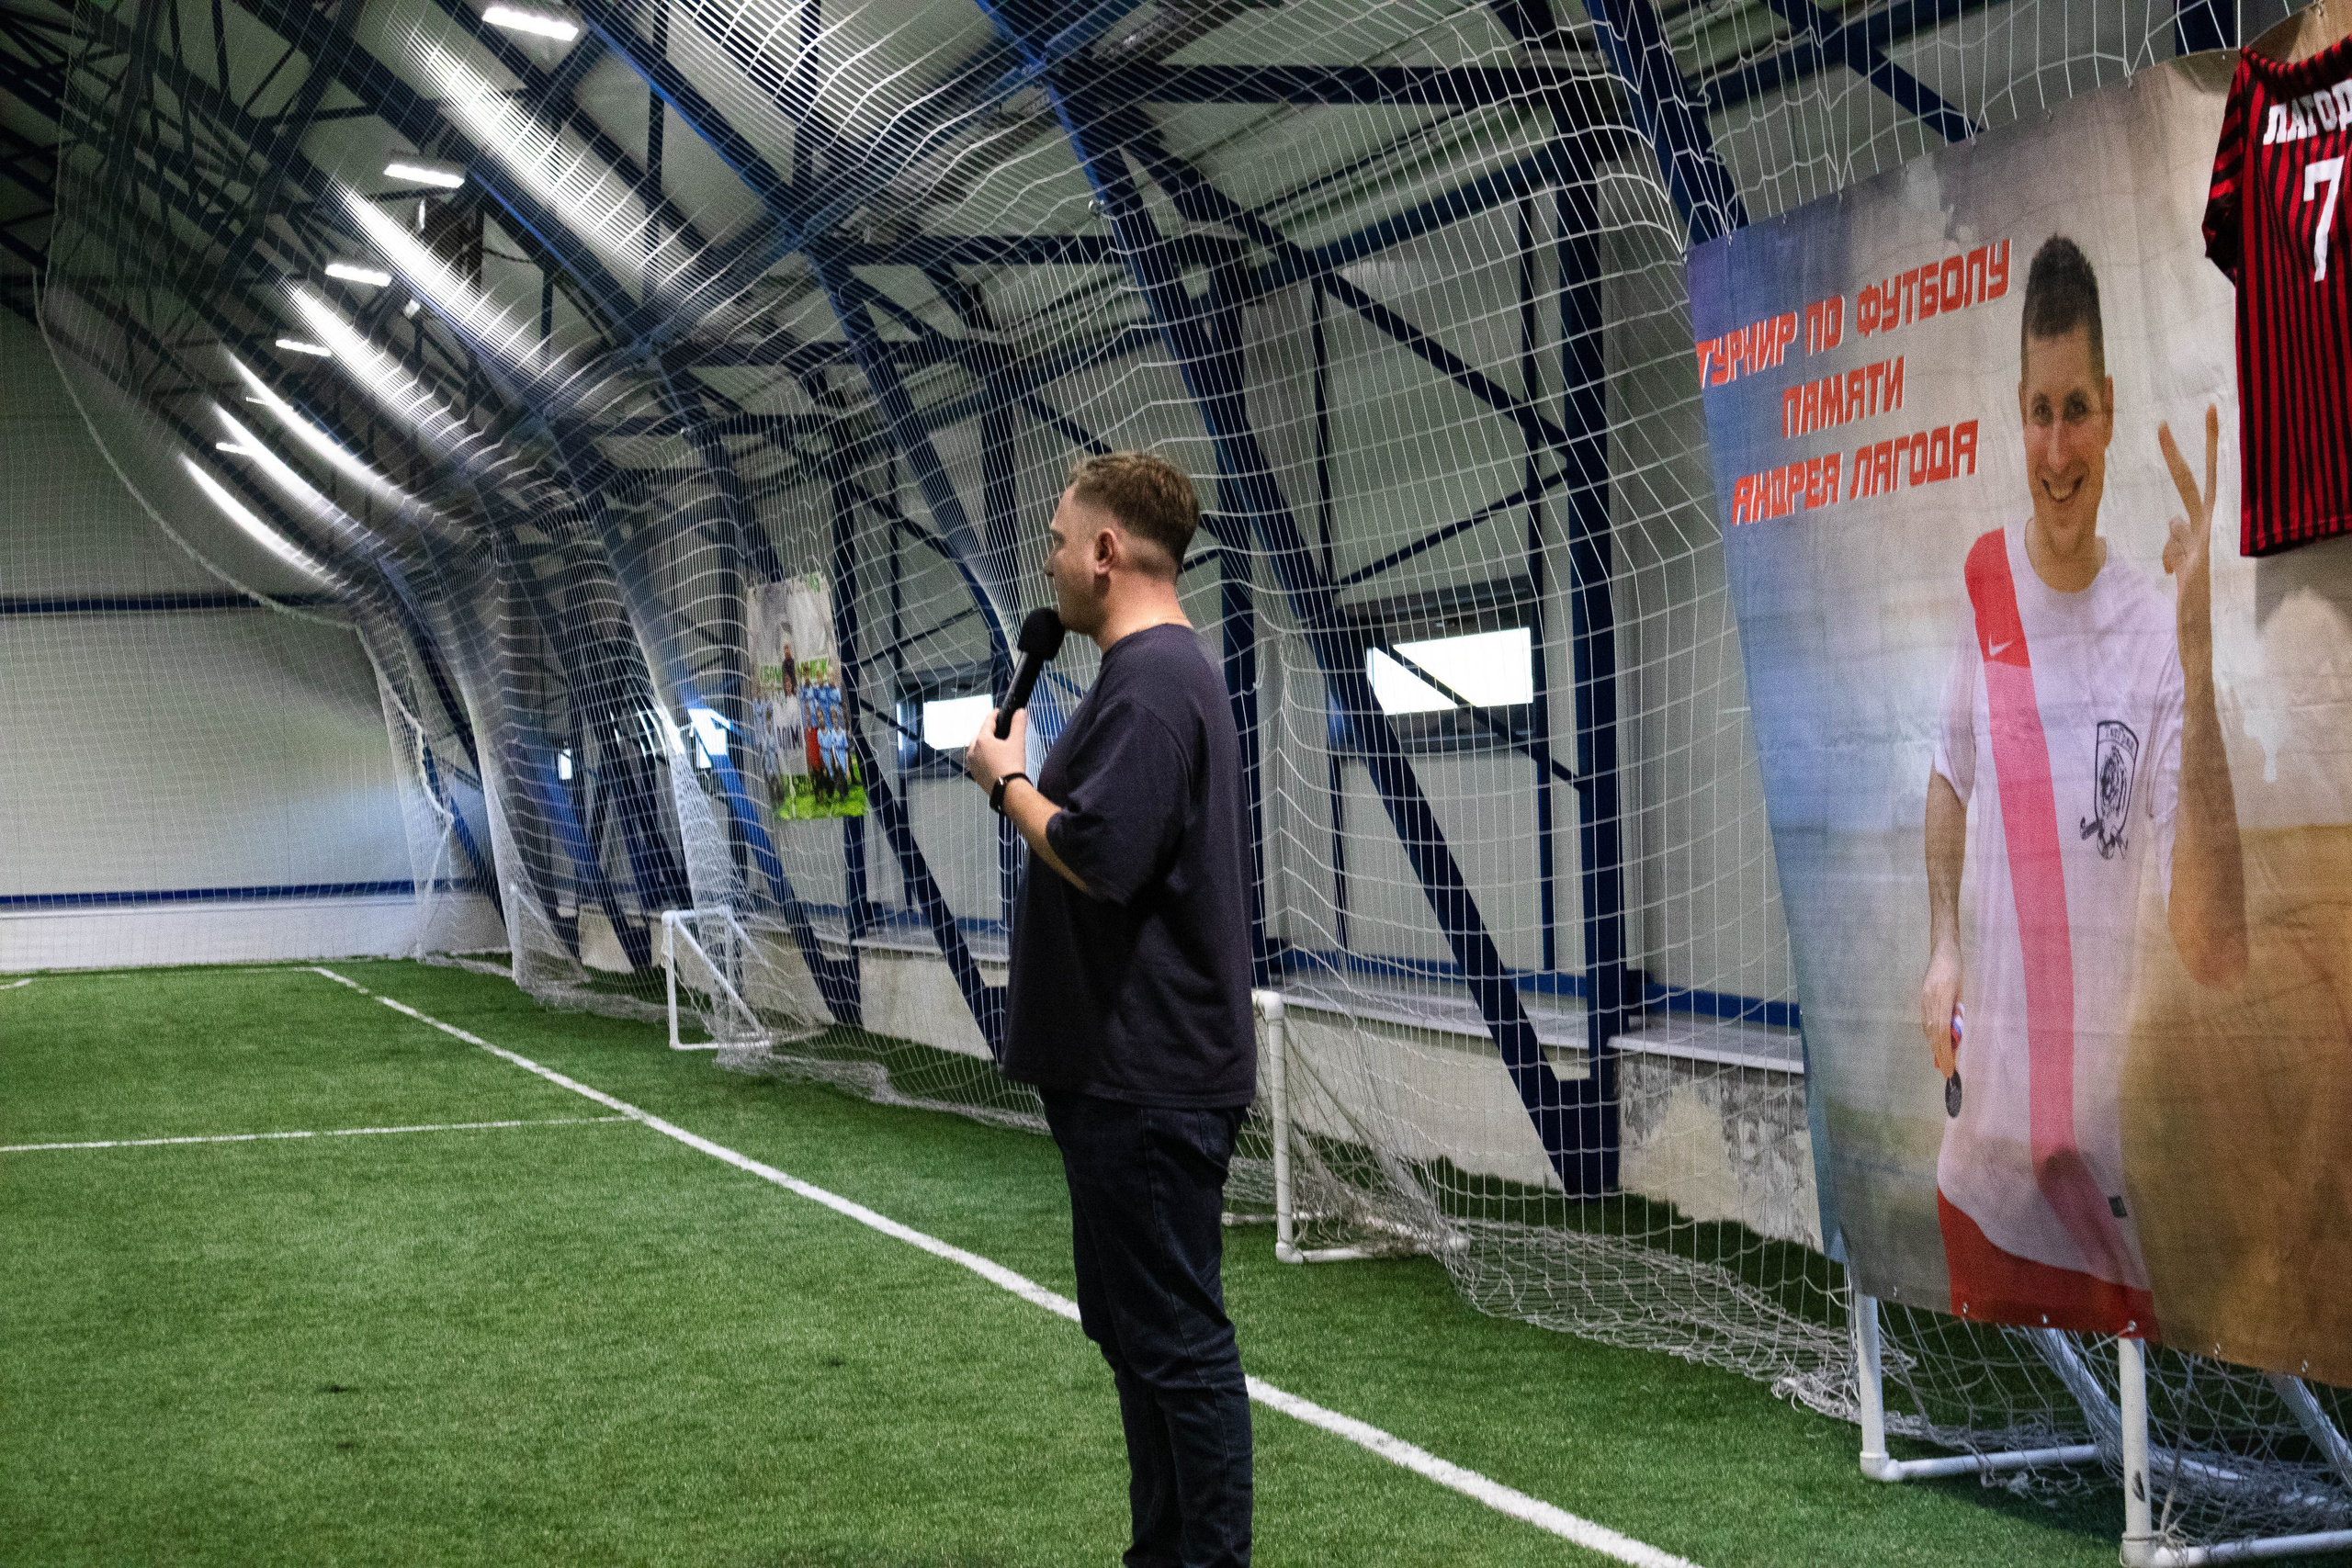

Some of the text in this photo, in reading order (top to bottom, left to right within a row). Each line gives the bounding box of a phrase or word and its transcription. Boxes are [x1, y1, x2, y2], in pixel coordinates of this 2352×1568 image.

[2303, 155, 2345, 283] 7
[1695, 238, 2012, 389] ТУРНИР ПО ФУТБОЛУ
[1782, 355, 1905, 439] ПАМЯТИ
[1732, 420, 1979, 525] АНДРЕЯ ЛАГОДА
